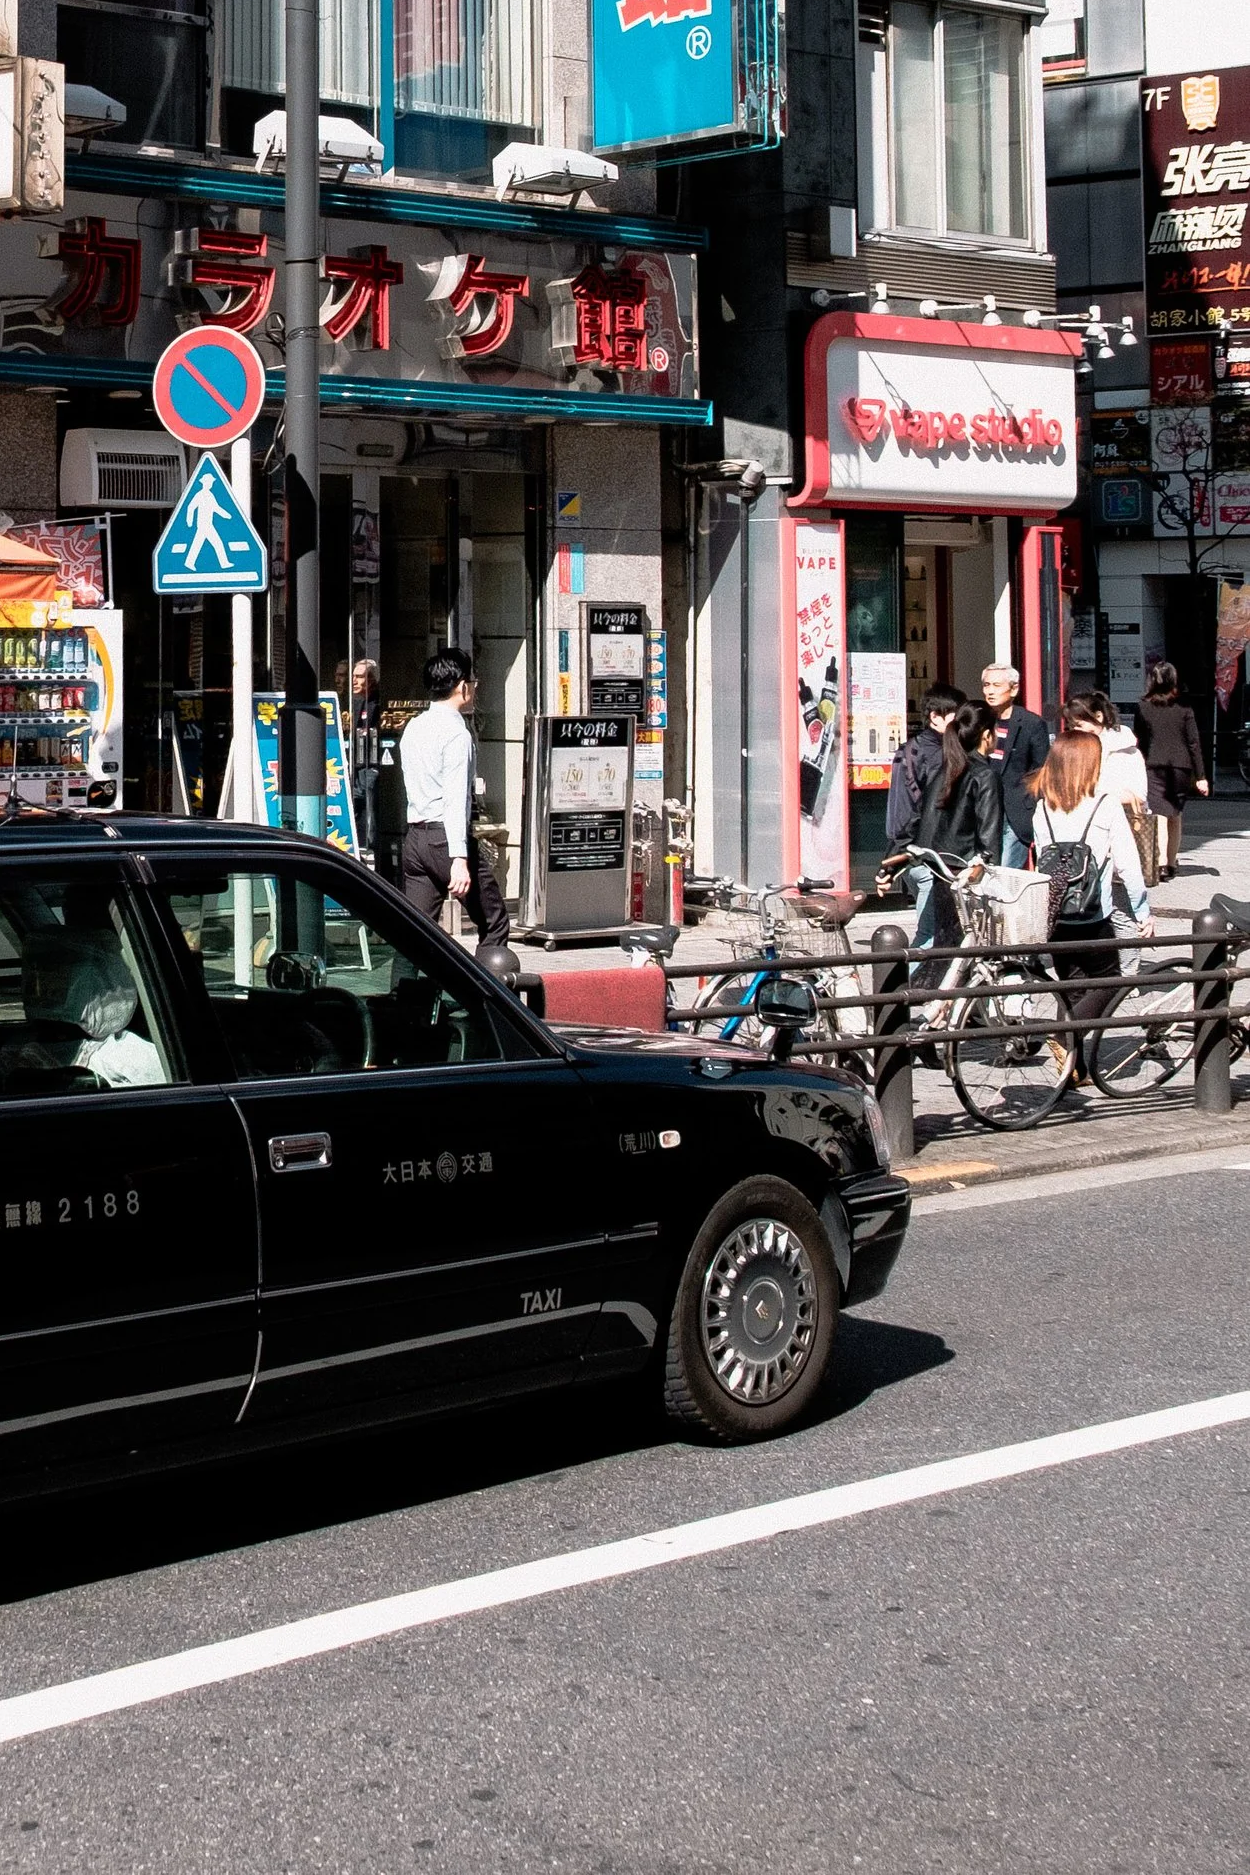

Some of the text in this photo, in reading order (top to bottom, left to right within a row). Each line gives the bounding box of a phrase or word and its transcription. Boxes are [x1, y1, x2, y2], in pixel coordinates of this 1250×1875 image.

[1142, 86, 1172, 112] 7F
[1148, 237, 1243, 255] ZHANGLIANG
[55, 216, 649, 373] カラオケ館
[1150, 306, 1225, 328] 胡家小館
[889, 407, 1063, 449] vape studio
[796, 556, 837, 570] VAPE
[800, 616, 834, 646] もっと
[560, 721, 619, 738] 只今の料金
[383, 1151, 494, 1184] 大日本 交通
[58, 1189, 140, 1223] 2188
[519, 1287, 563, 1314] TAXI
